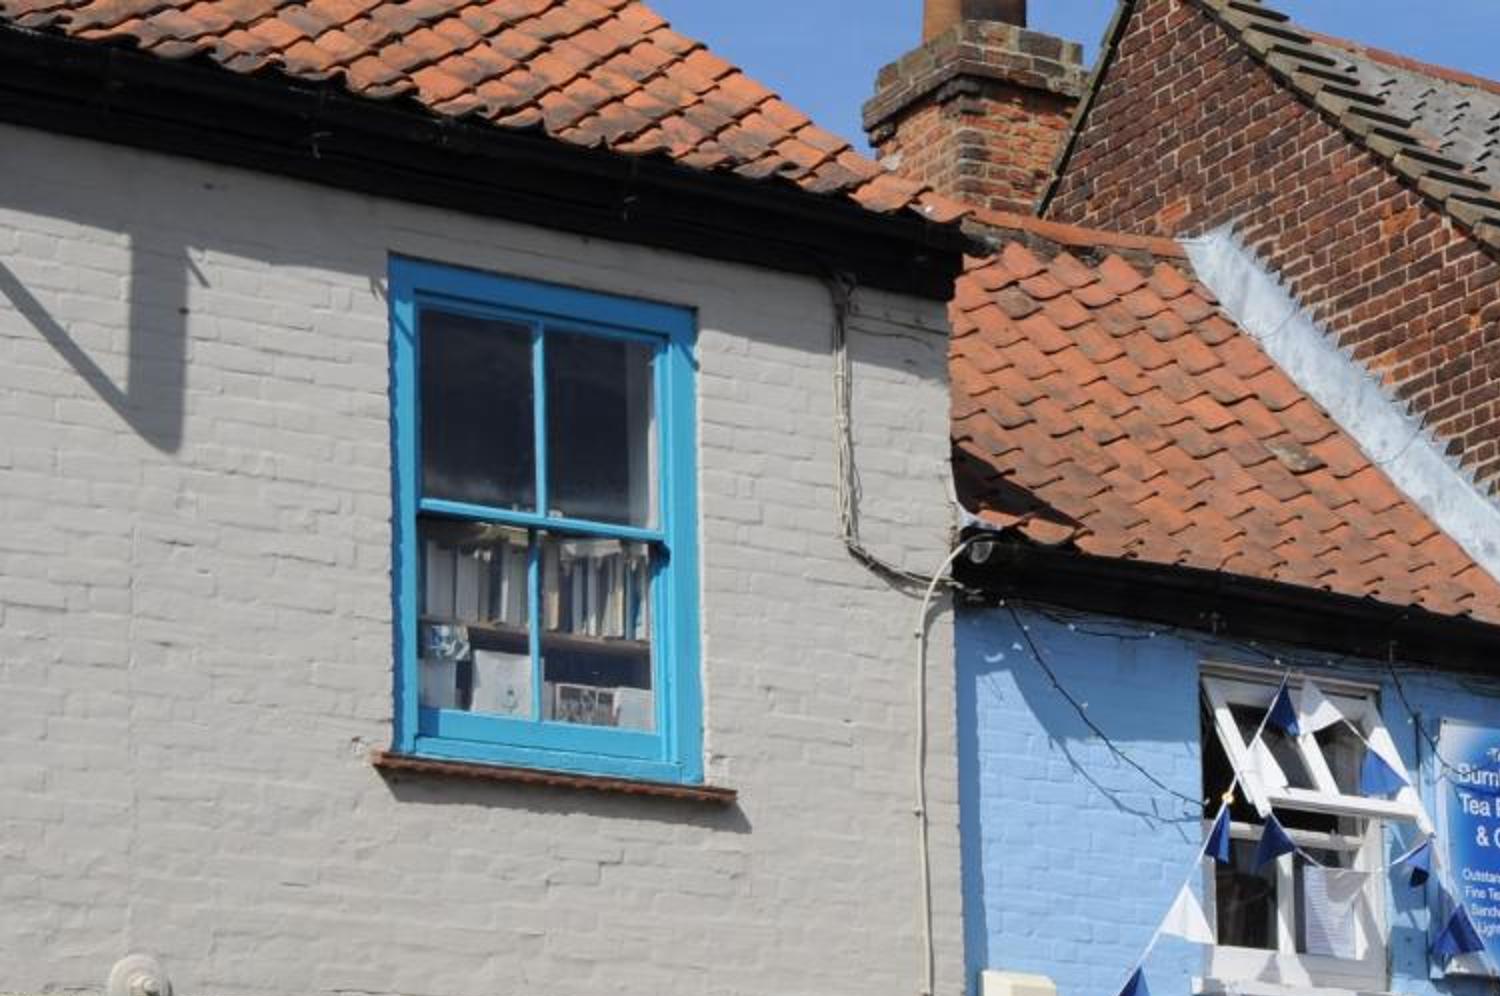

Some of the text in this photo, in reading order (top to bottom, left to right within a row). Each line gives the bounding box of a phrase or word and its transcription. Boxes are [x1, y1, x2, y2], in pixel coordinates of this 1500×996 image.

[1459, 792, 1491, 817] Tea
[1476, 825, 1489, 847] &
[1465, 885, 1487, 900] Fine
